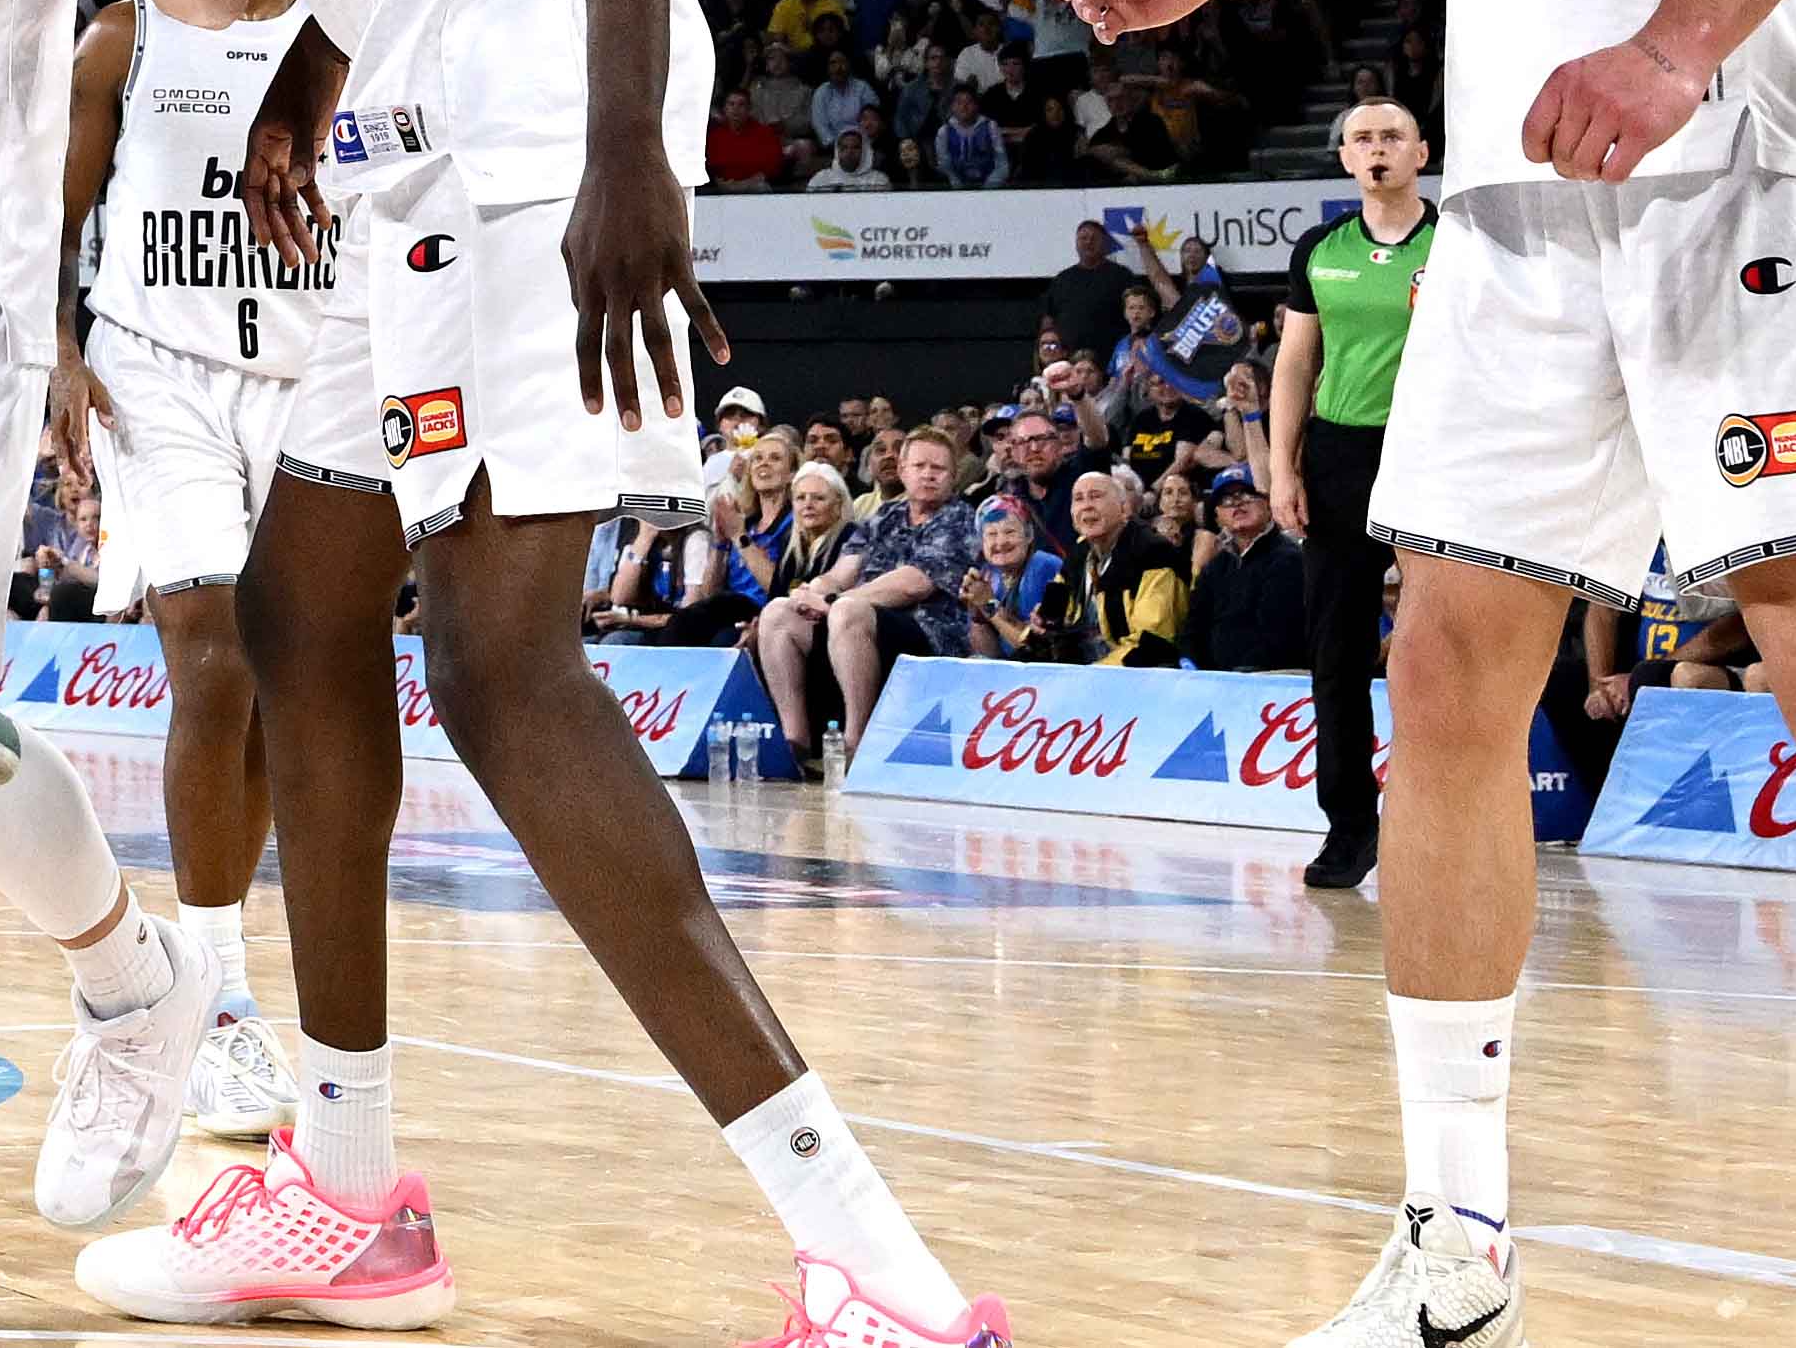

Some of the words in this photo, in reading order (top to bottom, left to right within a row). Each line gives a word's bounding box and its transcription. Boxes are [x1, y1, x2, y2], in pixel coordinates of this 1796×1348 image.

[226, 51, 268, 61] OPTUS
[153, 89, 230, 100] OMODA
[154, 102, 230, 114] JAECOO
[860, 227, 899, 241] CITY
[904, 227, 929, 241] OF
[1192, 207, 1303, 249] UniSC
[860, 244, 953, 259] MORETON
[959, 243, 991, 258] BAY
[238, 298, 259, 359] 6
[1724, 434, 1750, 465] NBL
[65, 642, 170, 709] Coors
[962, 686, 1136, 777] Coors
